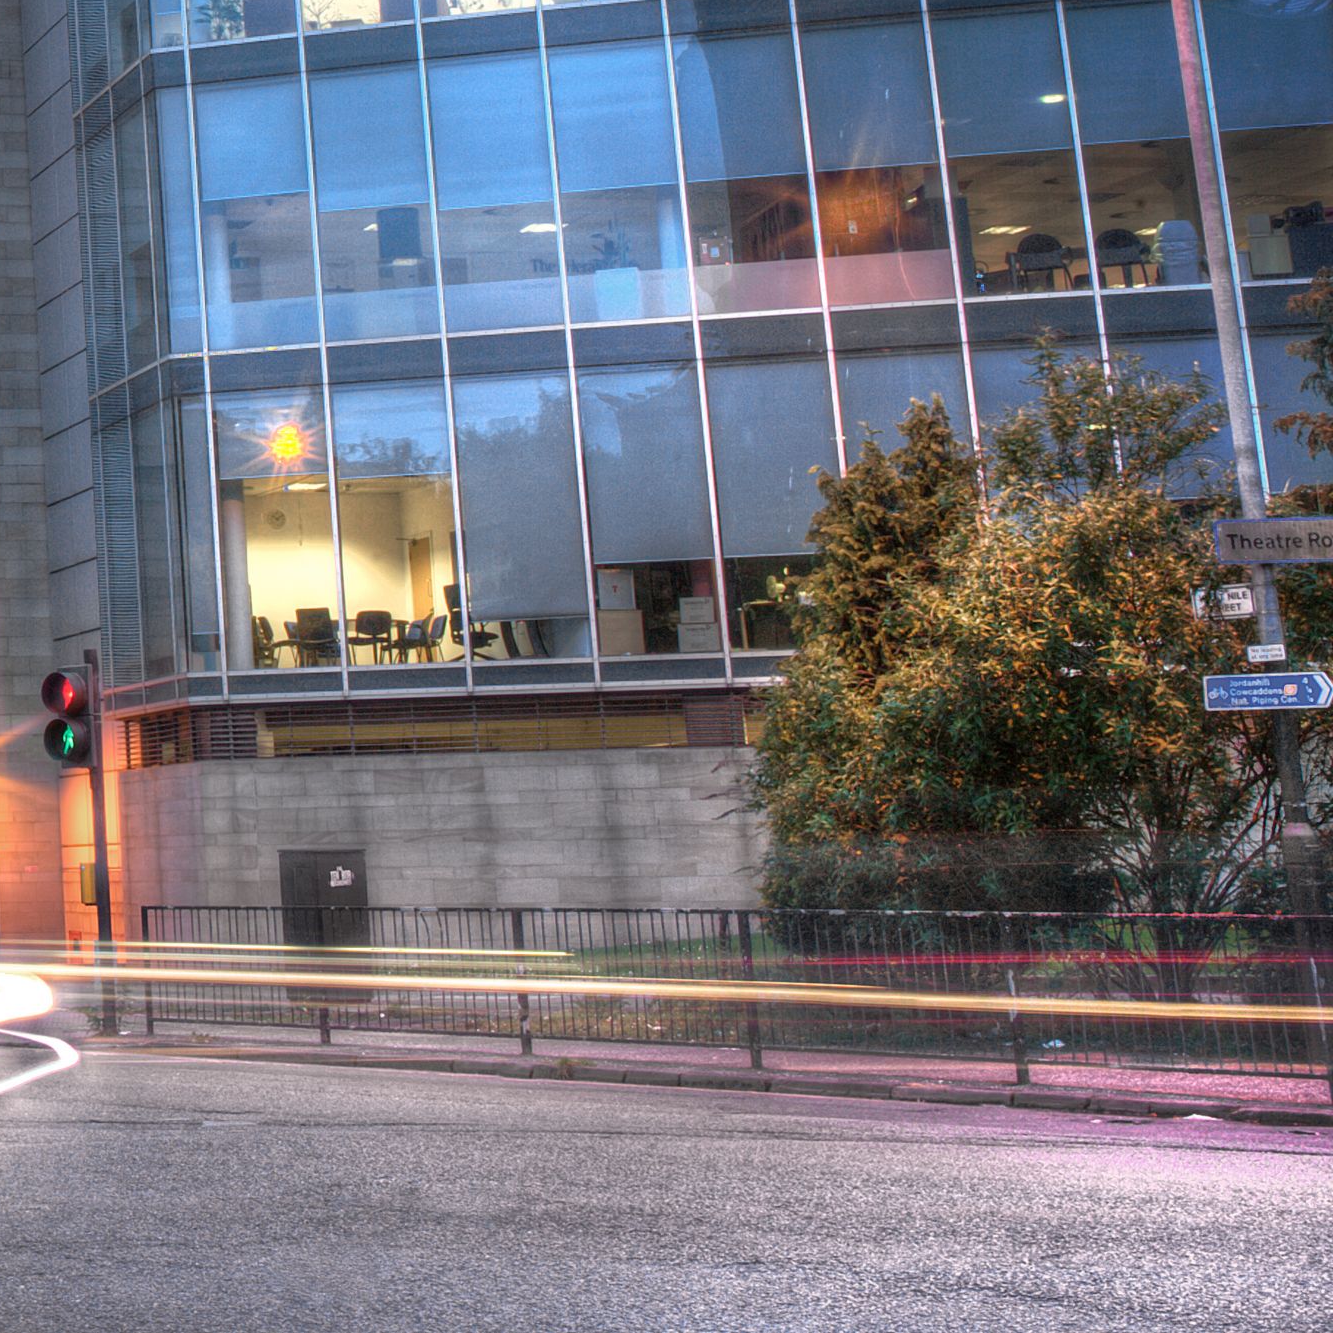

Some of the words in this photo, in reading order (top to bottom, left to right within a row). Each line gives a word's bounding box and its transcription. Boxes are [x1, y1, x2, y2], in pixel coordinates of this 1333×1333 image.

[1226, 533, 1303, 549] Theatre
[1308, 532, 1333, 548] Ro
[1227, 590, 1248, 600] NILE
[1230, 678, 1270, 687] Jordanhill
[1230, 687, 1283, 696] Cowcaddens
[1252, 695, 1279, 705] Piping
